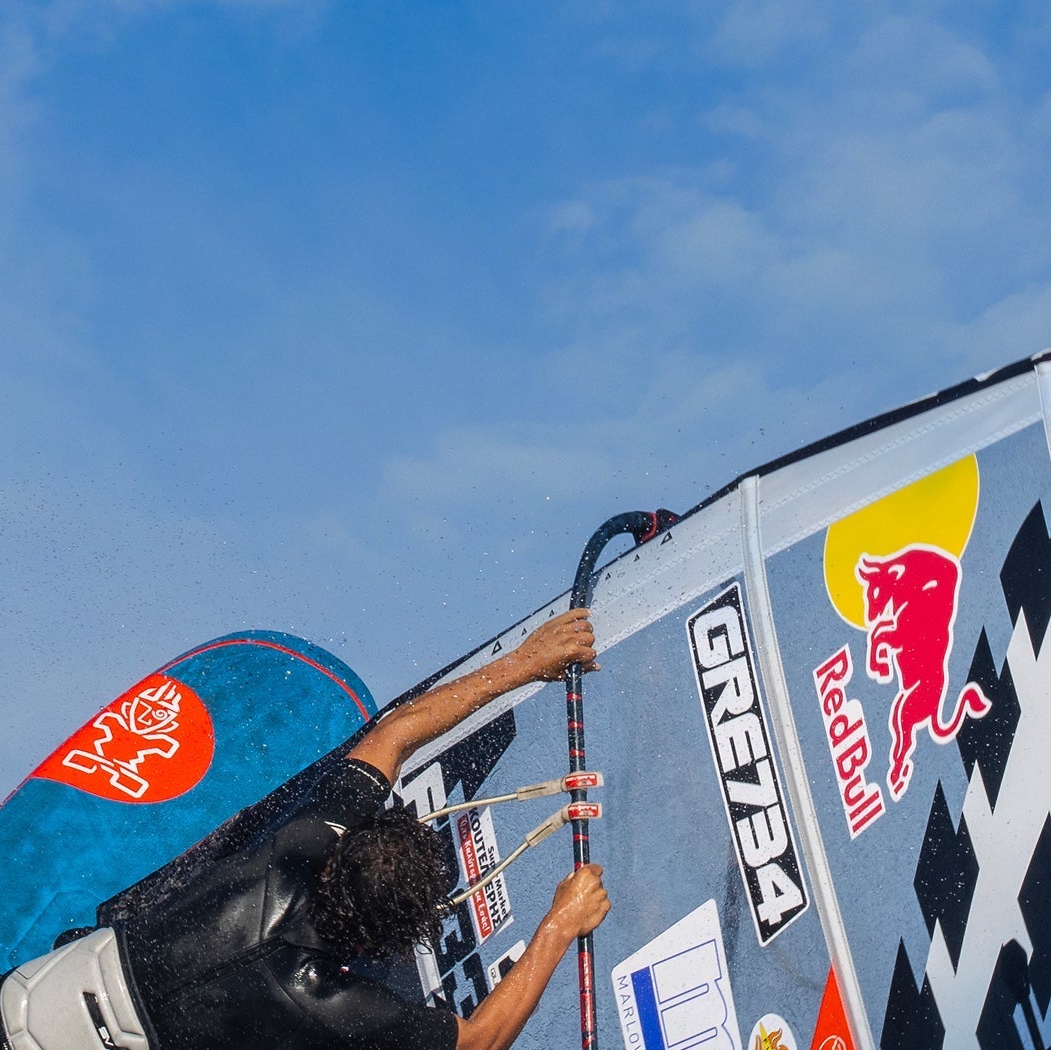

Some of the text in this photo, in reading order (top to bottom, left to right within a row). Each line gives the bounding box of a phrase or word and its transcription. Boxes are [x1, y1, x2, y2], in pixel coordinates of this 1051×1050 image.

[693, 605, 804, 926] GRE734
[488, 846, 511, 919] Sup Market
